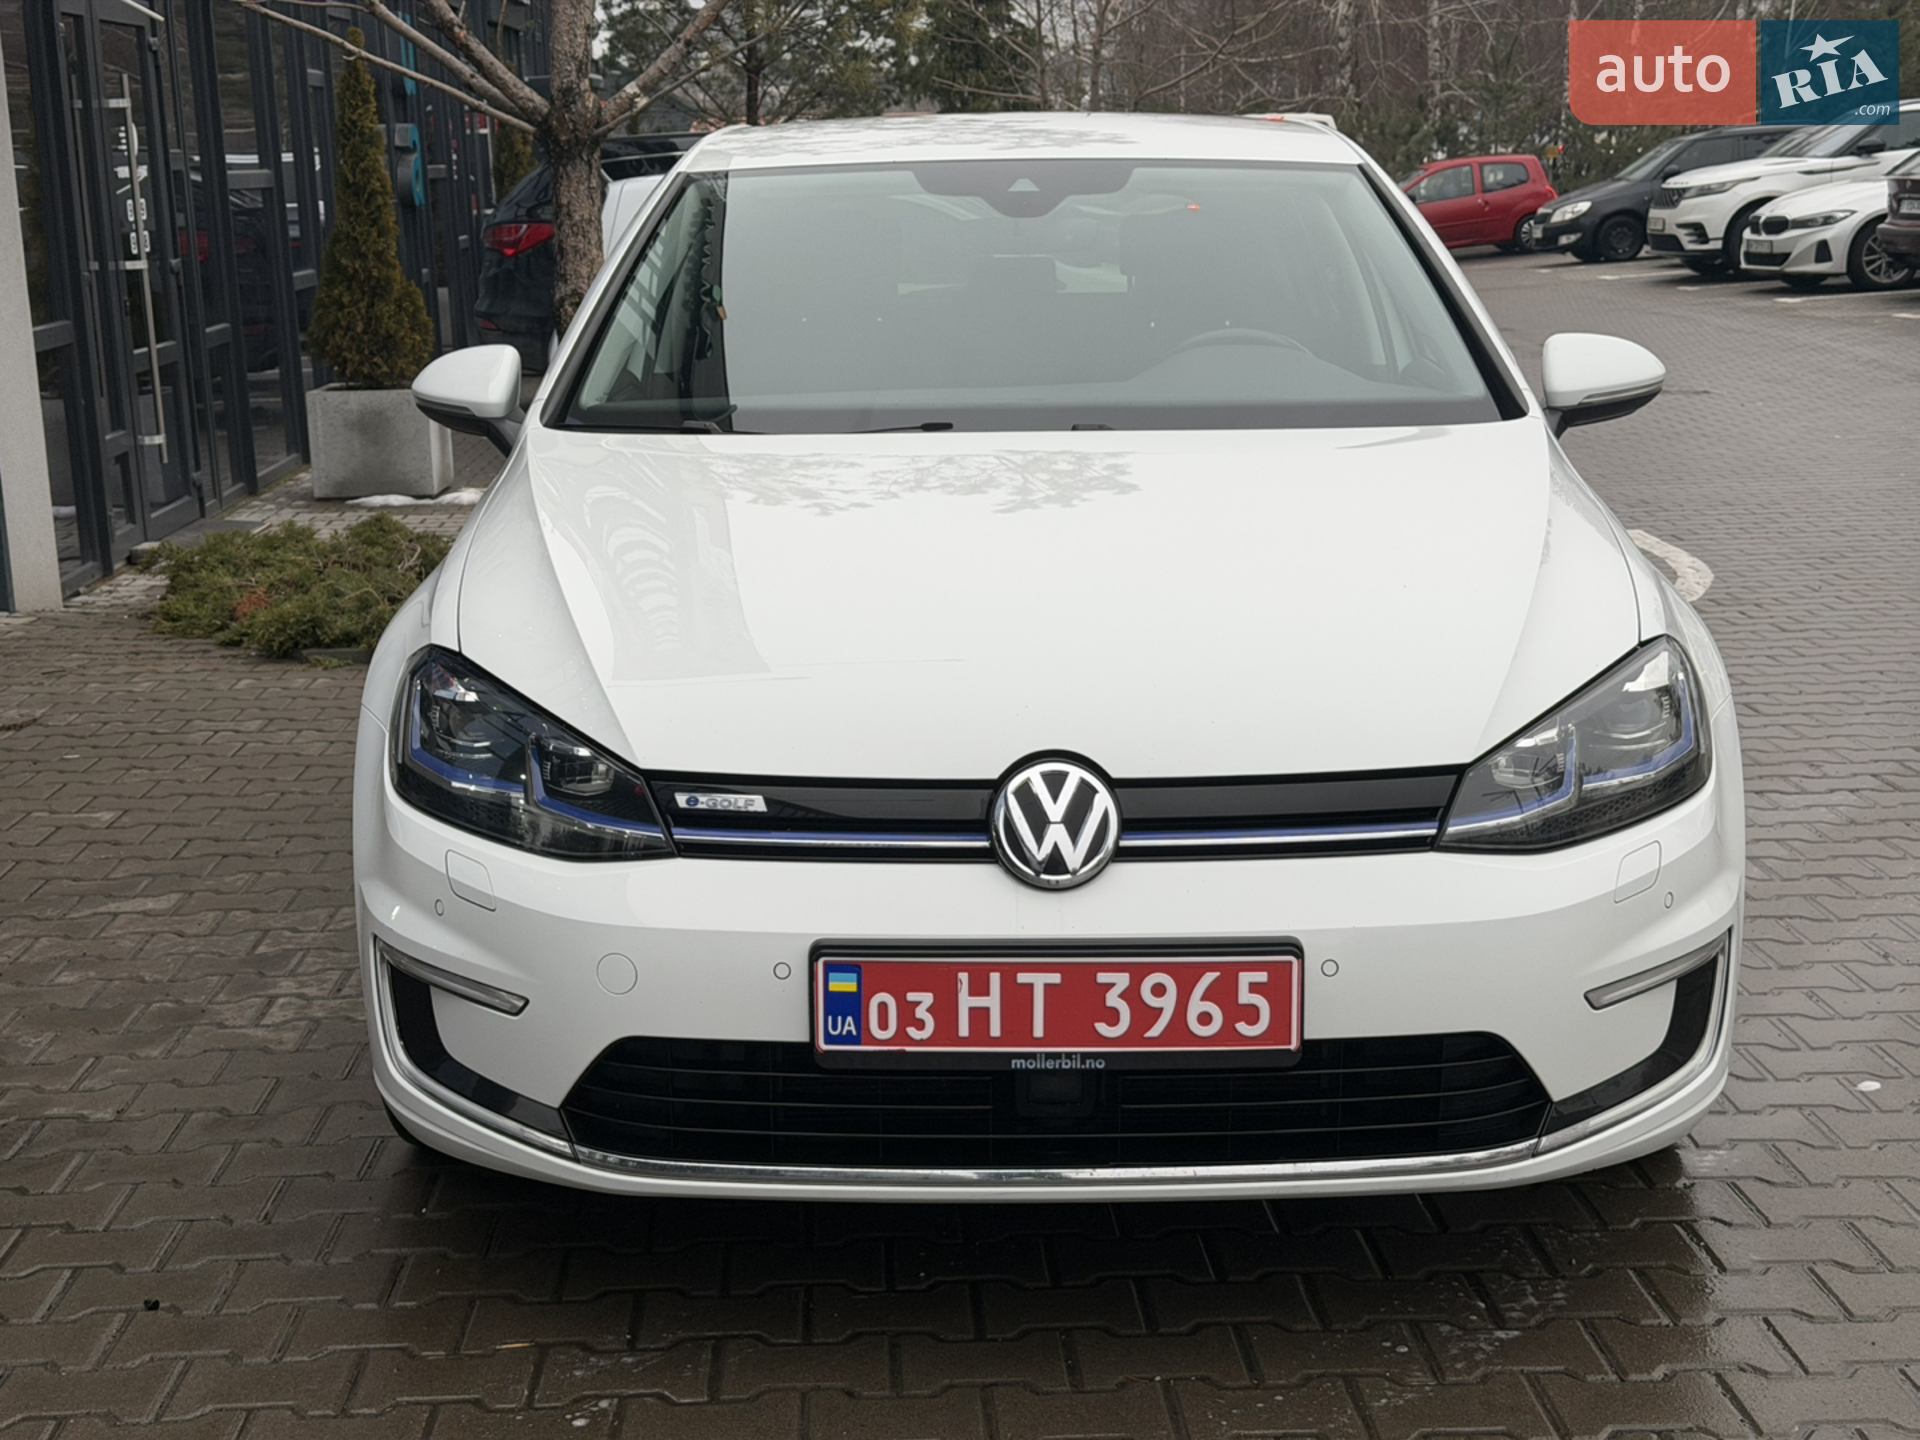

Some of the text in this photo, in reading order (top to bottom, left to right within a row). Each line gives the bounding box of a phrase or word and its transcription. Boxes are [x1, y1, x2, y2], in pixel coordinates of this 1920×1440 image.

[868, 971, 1271, 1041] 03 HT 3965
[827, 1015, 857, 1037] UA
[1011, 1053, 1105, 1069] mollerbil.no
